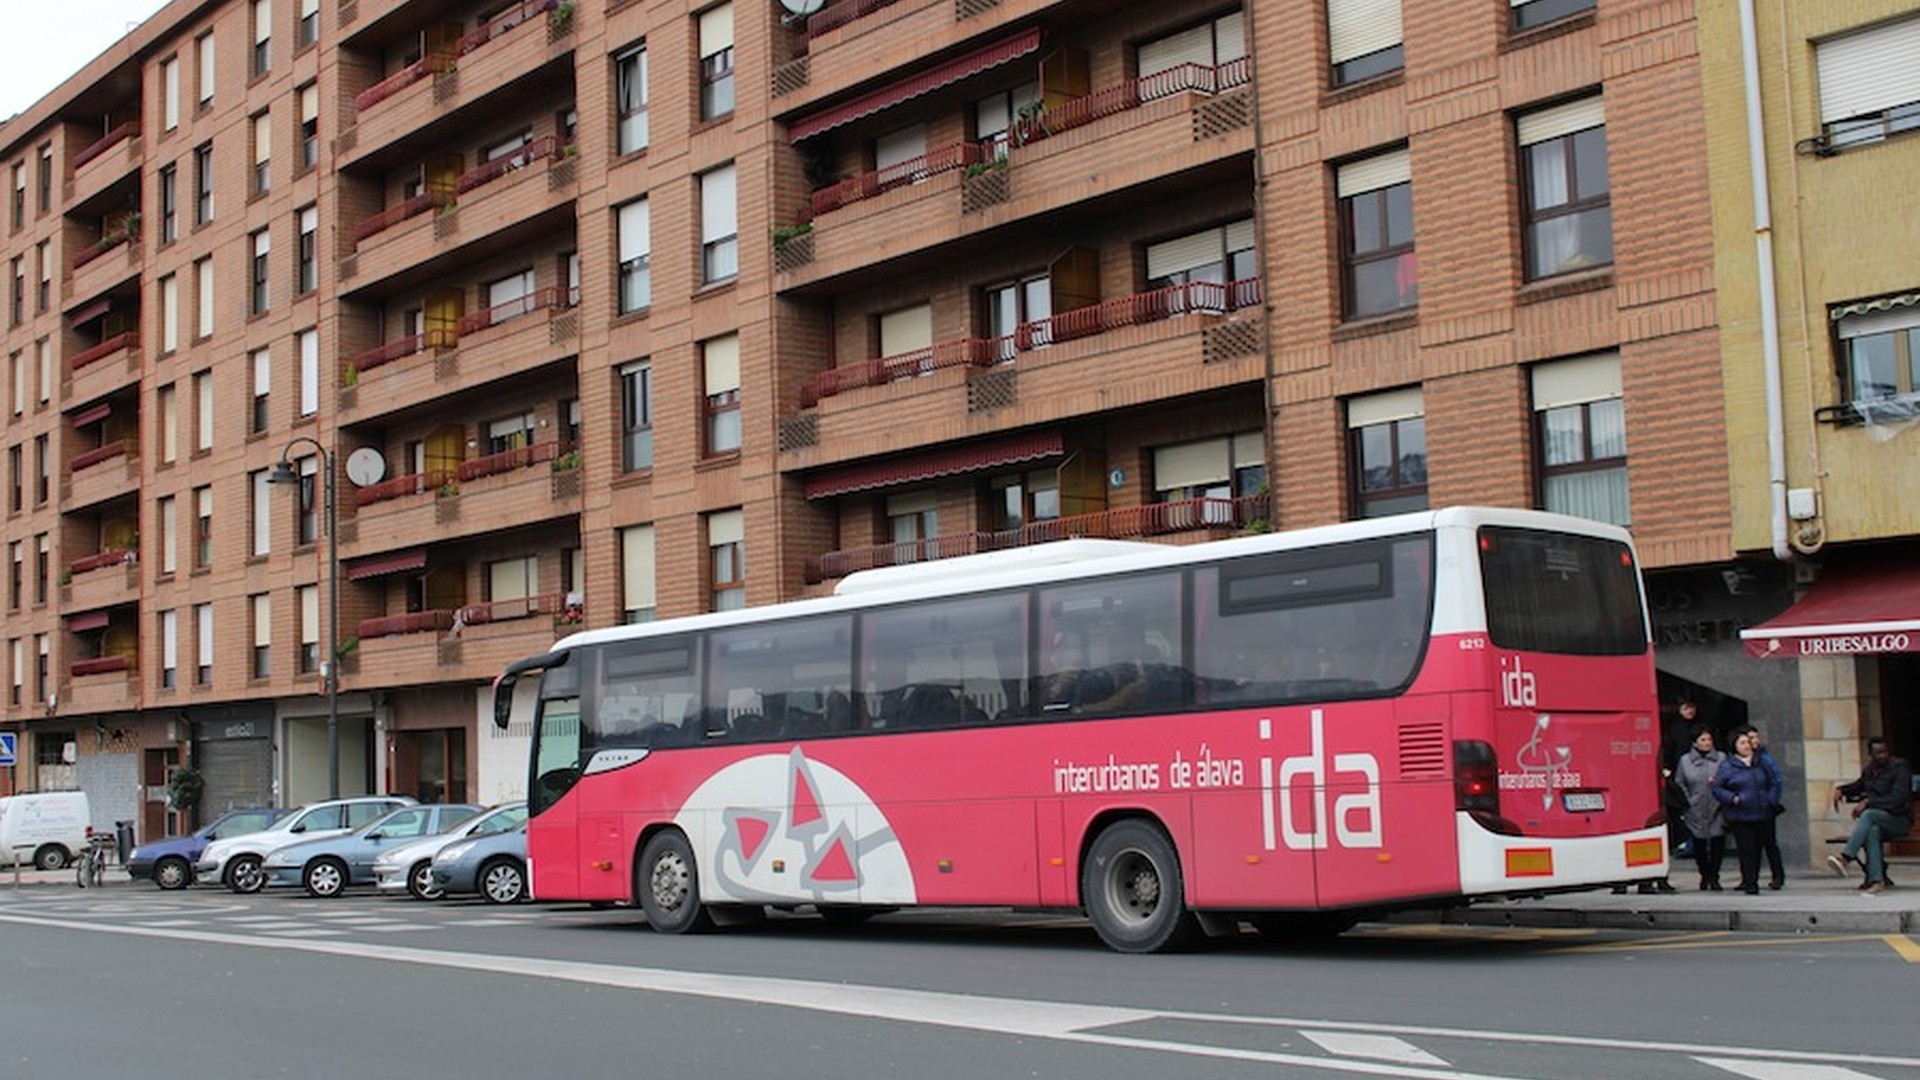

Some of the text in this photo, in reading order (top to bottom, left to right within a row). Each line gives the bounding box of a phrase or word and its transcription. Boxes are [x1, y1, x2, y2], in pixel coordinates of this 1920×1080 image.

[1459, 638, 1484, 649] 6212
[1801, 634, 1909, 654] URIBESALGO
[1501, 655, 1536, 707] ida
[1054, 743, 1244, 793] interurbanos de álava
[1259, 709, 1383, 850] ida
